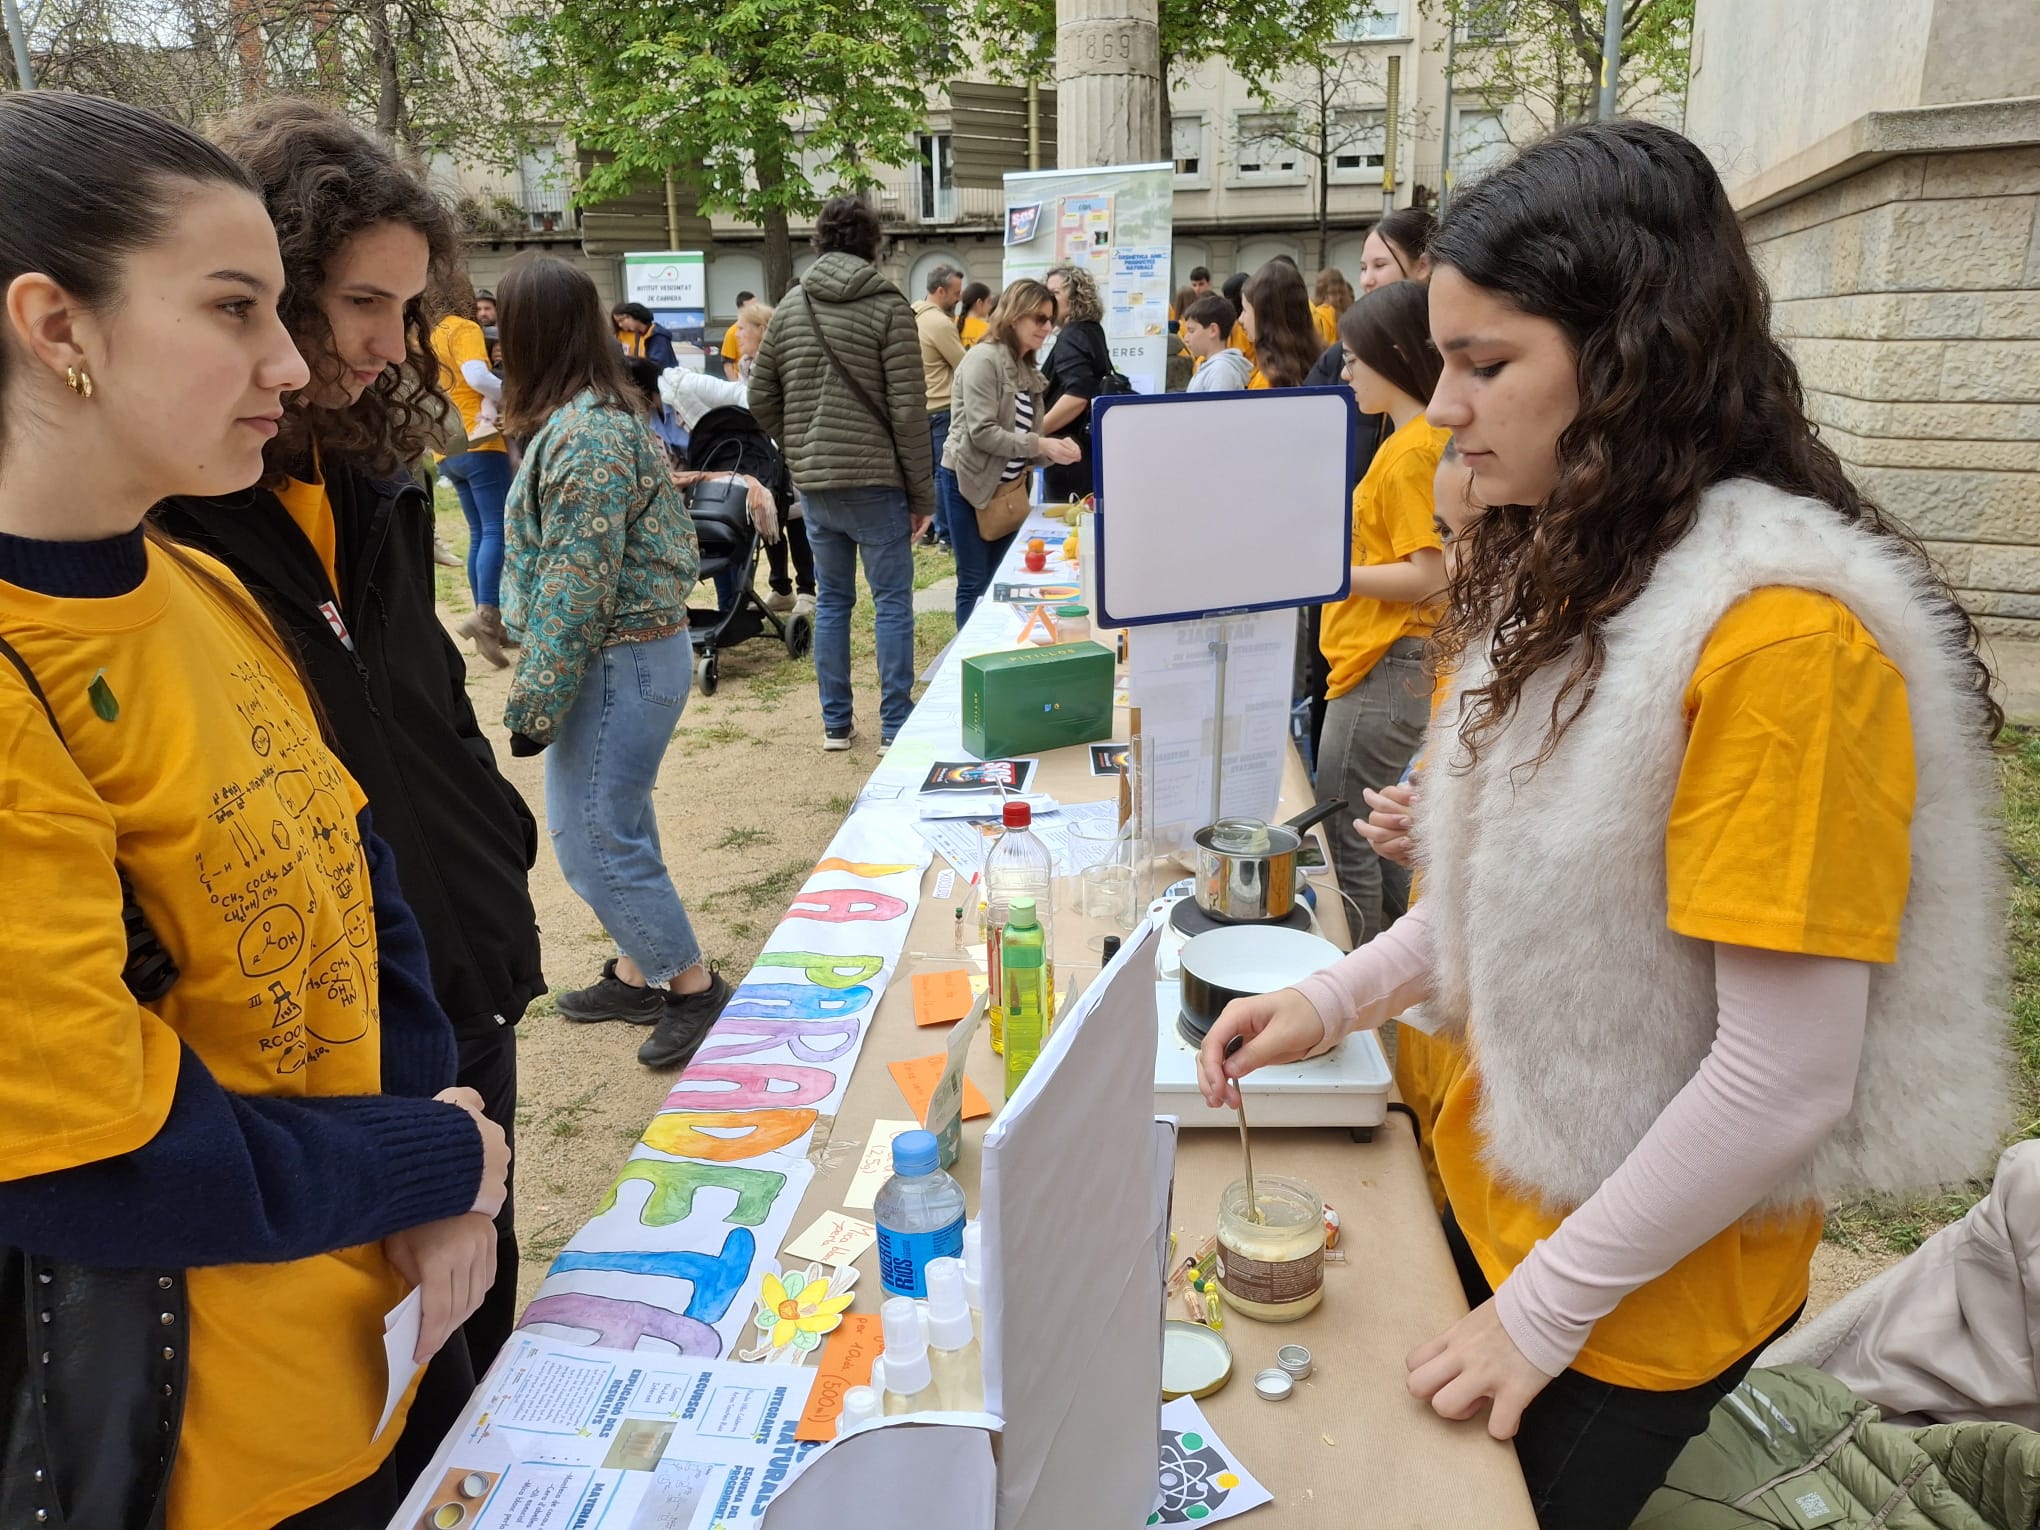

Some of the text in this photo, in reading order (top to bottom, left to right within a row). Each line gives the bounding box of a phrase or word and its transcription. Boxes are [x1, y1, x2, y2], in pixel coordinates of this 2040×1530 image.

[1112, 346, 1145, 358] ERES
[592, 1379, 624, 1425] RESULTATS
[599, 1369, 643, 1438] EXPLICACIÓ DELS
[681, 1371, 713, 1420] RECURSOS
[755, 1386, 788, 1444] INTEGRANTS
[715, 1465, 743, 1520] PROCEDIMENT
[727, 1467, 755, 1520] ESQUEMA DEL
